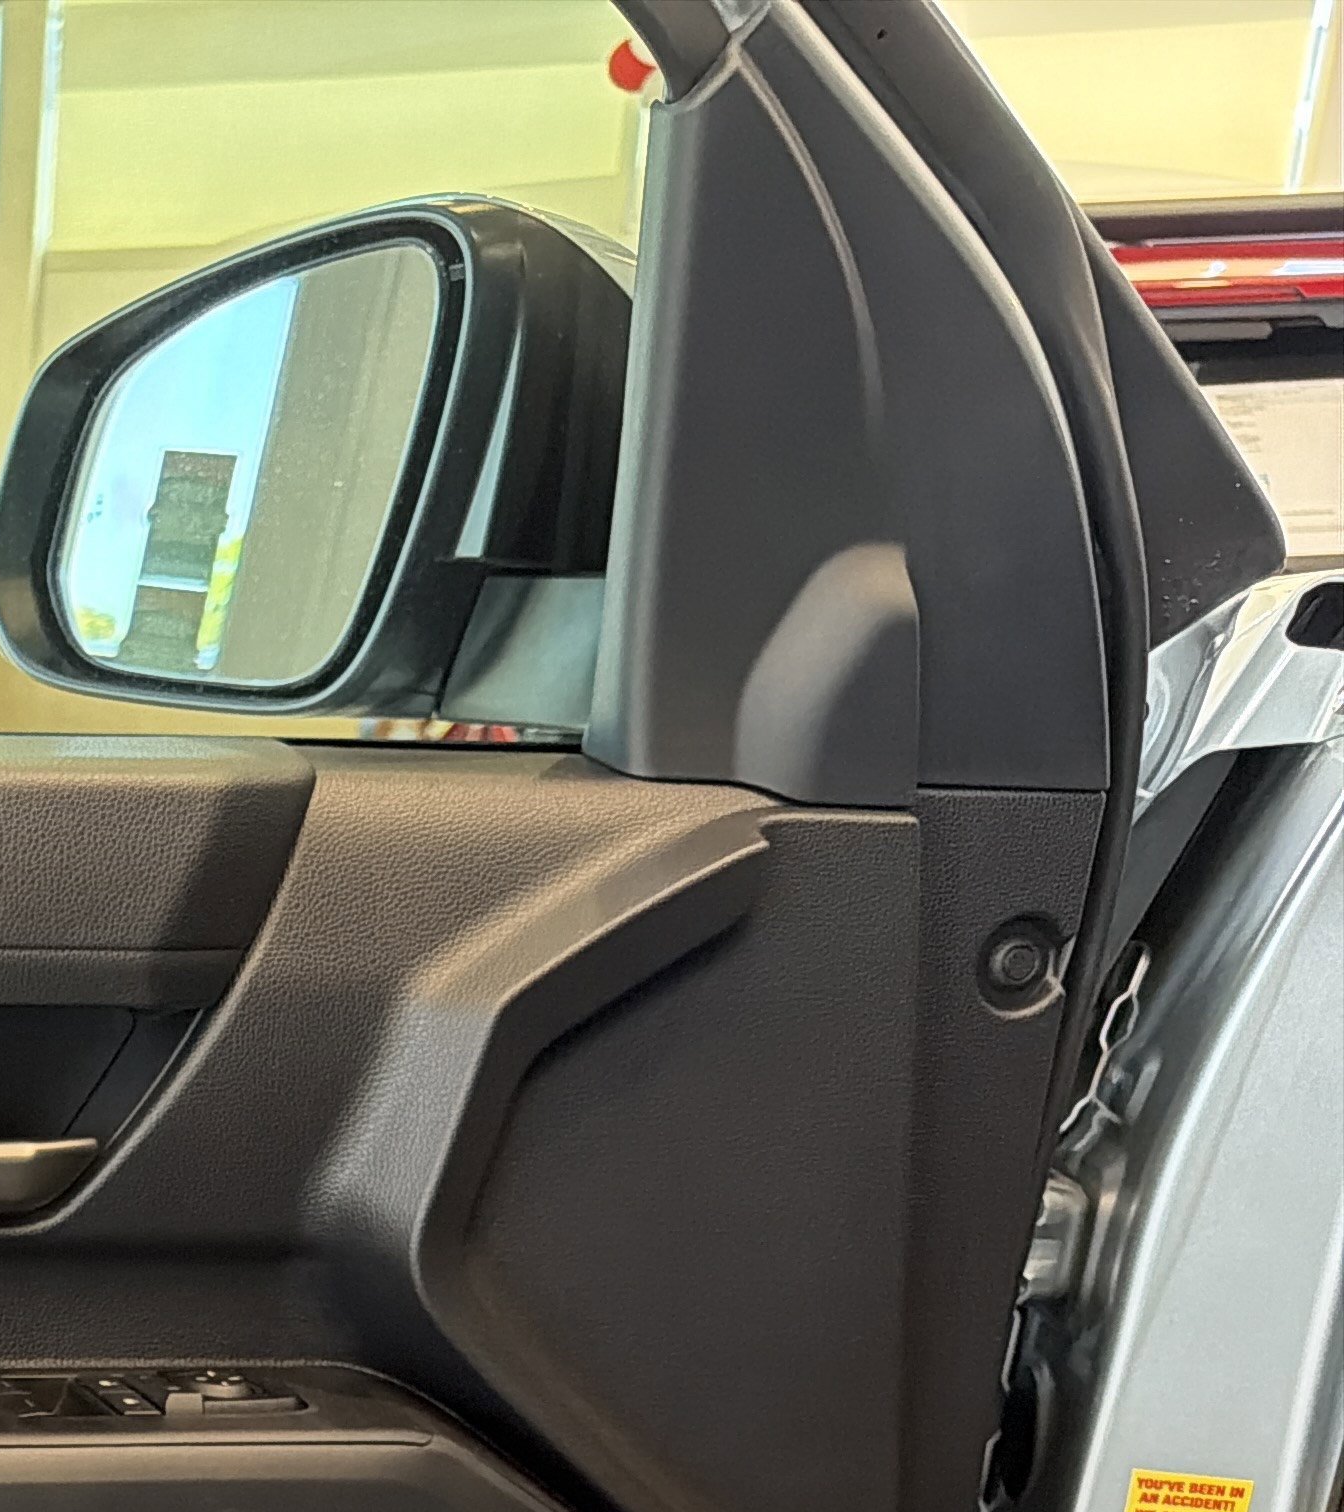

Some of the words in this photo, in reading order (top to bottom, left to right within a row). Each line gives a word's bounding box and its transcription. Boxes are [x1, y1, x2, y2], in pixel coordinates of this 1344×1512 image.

[1137, 1477, 1185, 1493] YOU'VE
[1188, 1481, 1225, 1496] BEEN
[1229, 1486, 1246, 1498] IN
[1138, 1492, 1157, 1504] AN
